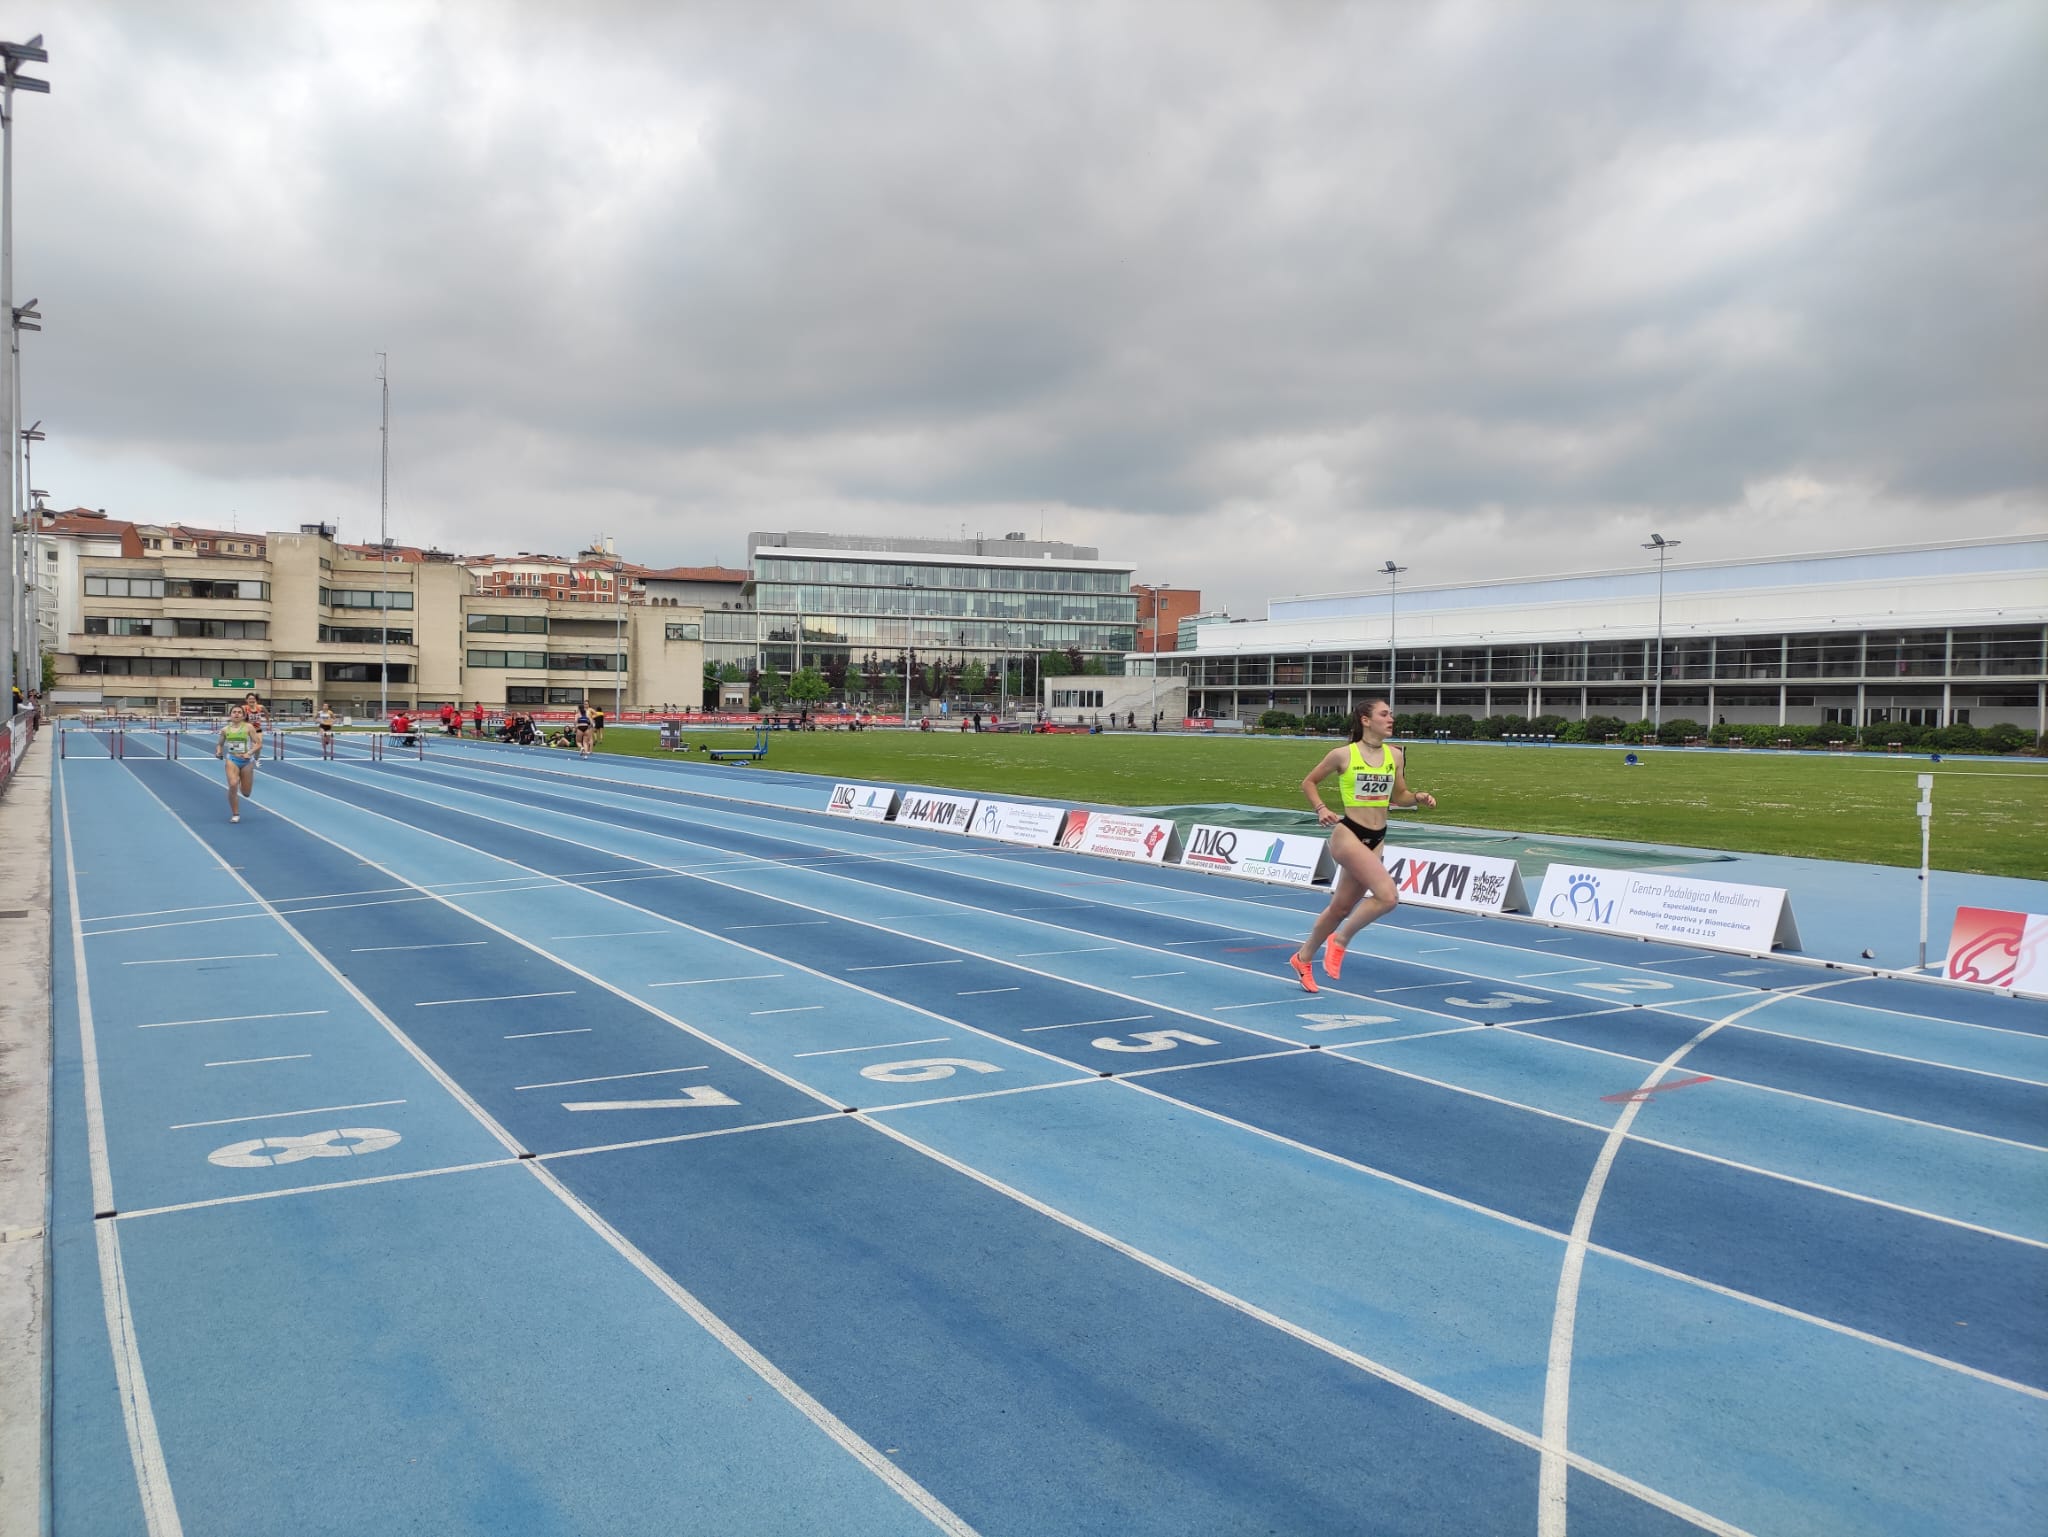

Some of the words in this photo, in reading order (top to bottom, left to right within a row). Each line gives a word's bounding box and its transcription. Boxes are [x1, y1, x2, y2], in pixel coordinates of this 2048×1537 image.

[1362, 783, 1388, 793] 420
[832, 787, 855, 809] IMQ
[909, 800, 957, 825] A4XKM
[1190, 828, 1238, 864] IMQ
[1267, 867, 1281, 877] San
[1282, 870, 1310, 882] Miguel
[1381, 856, 1471, 900] 4XKM
[1632, 881, 1661, 896] Centro
[1663, 902, 1706, 913] Especialistas
[1664, 913, 1697, 924] Deportiva
[1686, 927, 1701, 935] 412
[1702, 929, 1716, 937] 115
[1574, 978, 1674, 994] 2
[1444, 992, 1552, 1008] 3
[1296, 1013, 1400, 1031] 4
[1091, 1030, 1222, 1052] 5
[859, 1058, 1005, 1083] 6
[561, 1085, 741, 1112] 7
[207, 1126, 402, 1168] 8
